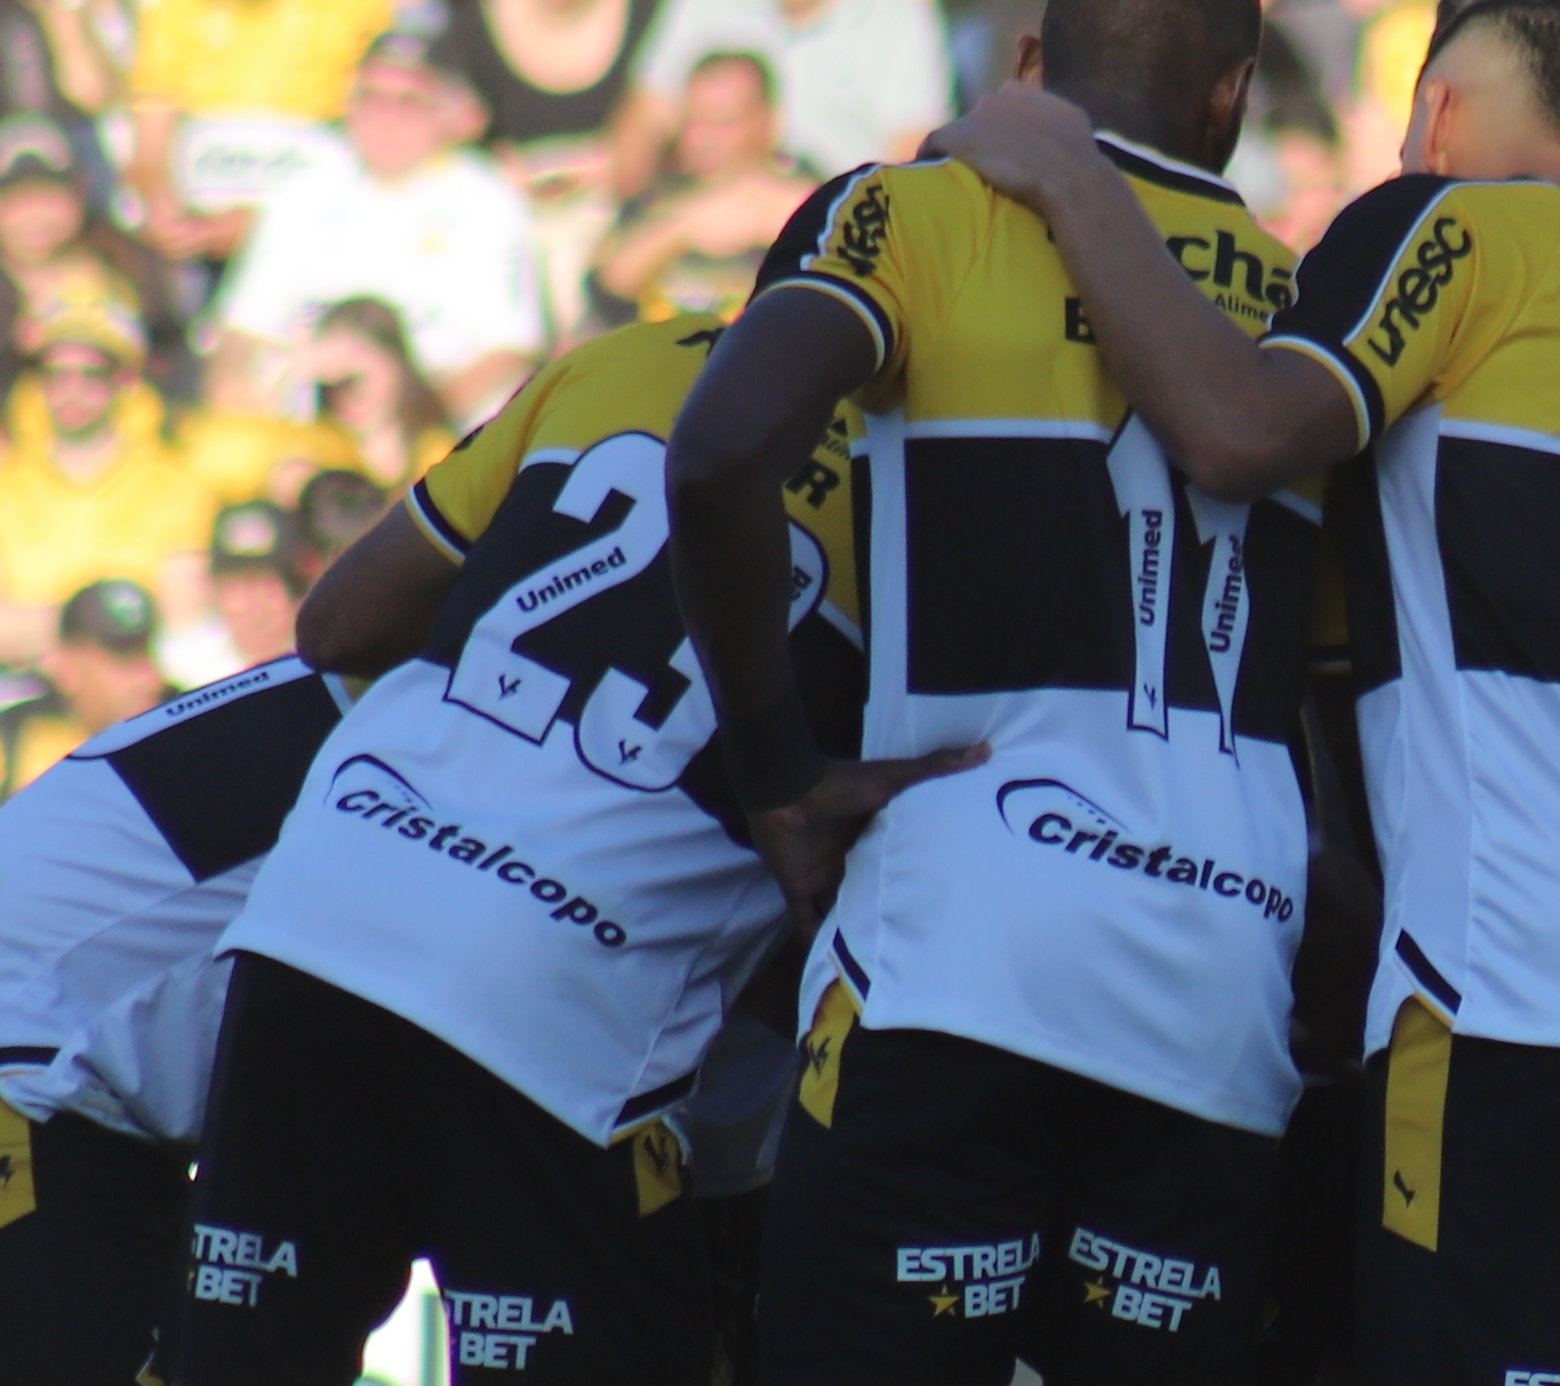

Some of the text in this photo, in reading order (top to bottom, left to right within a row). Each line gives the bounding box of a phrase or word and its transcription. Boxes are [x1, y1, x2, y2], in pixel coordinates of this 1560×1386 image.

[1367, 216, 1472, 367] unesc
[515, 548, 627, 614] Unimed
[1139, 508, 1163, 628] Unimed
[1209, 534, 1243, 655] Unimed
[164, 669, 272, 719] Unimed
[335, 786, 628, 951] Cristalcopo
[1028, 811, 1295, 924] Cristalcopo
[193, 1223, 298, 1278] TRELA
[896, 1231, 1040, 1282] ESTRELA
[1068, 1227, 1223, 1303] ESTRELA
[195, 1264, 263, 1308] BET
[443, 1288, 574, 1336] TRELA
[964, 1275, 1027, 1320] BET
[1111, 1285, 1193, 1334] BET
[459, 1330, 537, 1371] BET
